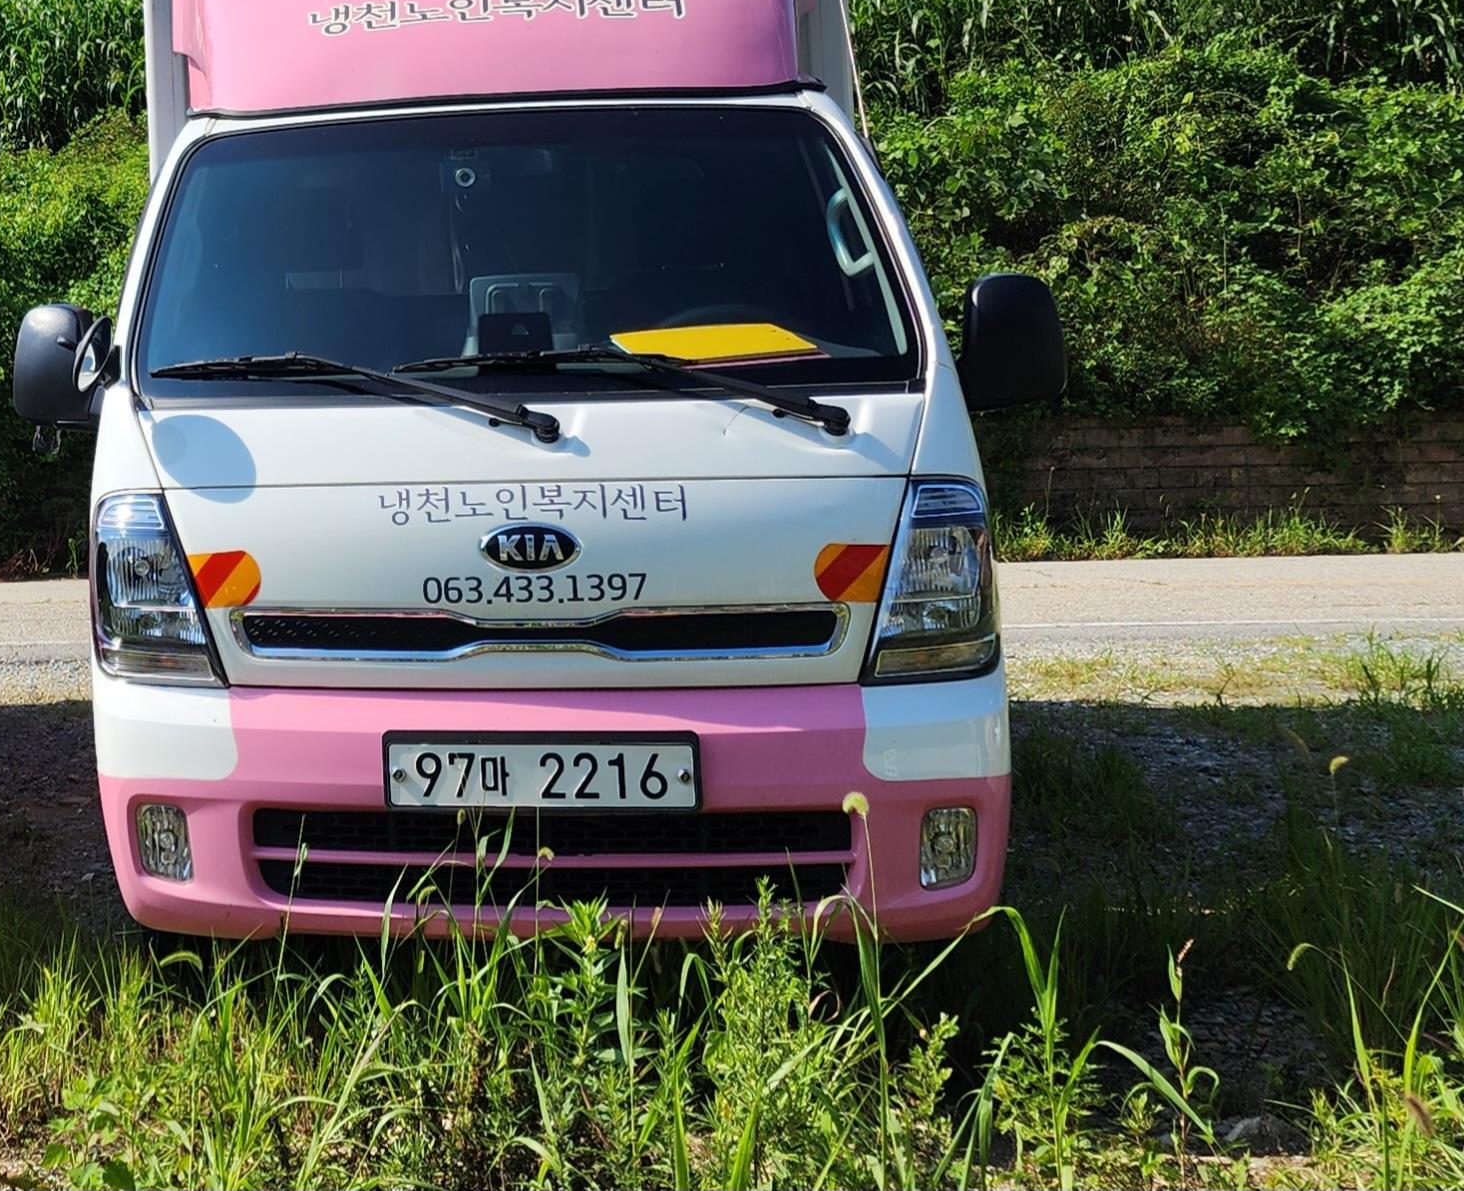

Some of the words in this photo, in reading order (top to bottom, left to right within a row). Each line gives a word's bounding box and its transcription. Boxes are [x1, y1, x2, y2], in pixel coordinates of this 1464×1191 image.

[378, 483, 688, 526] 냉천노인복지센터
[497, 534, 564, 562] KIA
[422, 573, 647, 604] 063.433.1397
[415, 752, 510, 798] 97마
[539, 752, 668, 800] 2216
